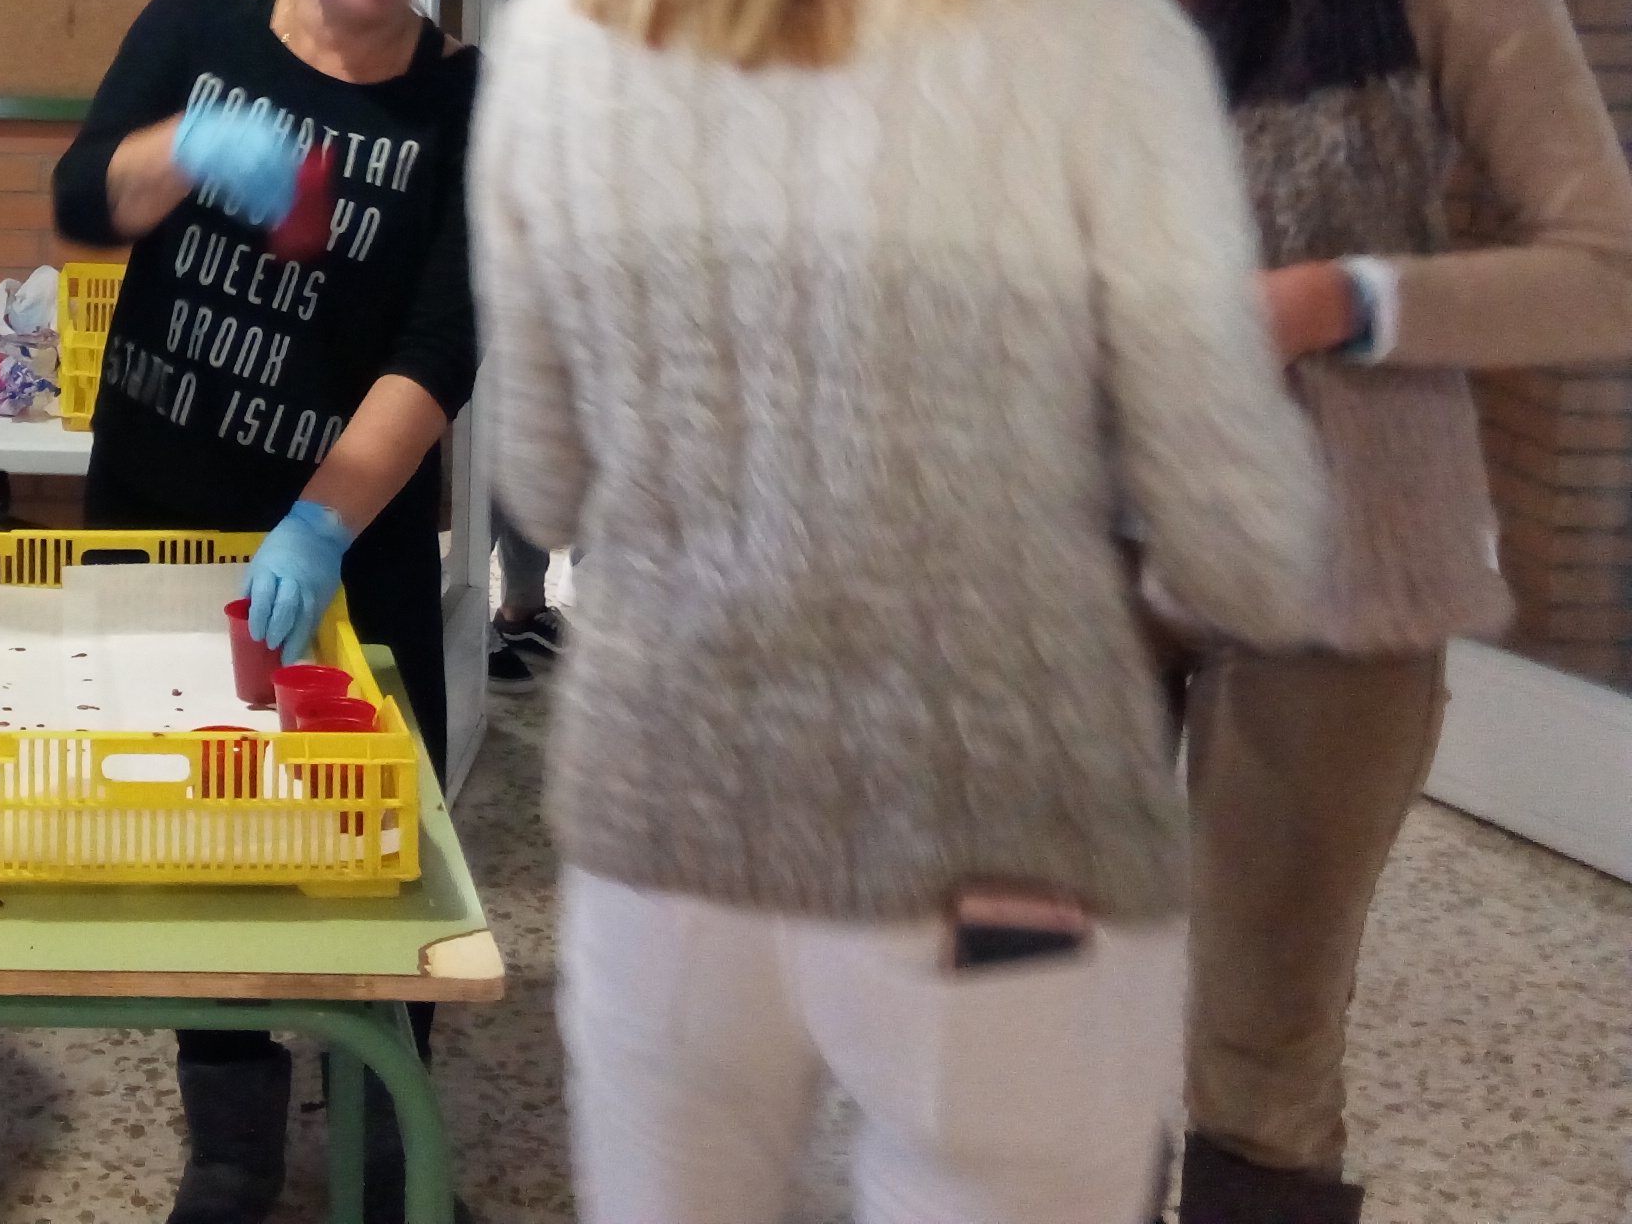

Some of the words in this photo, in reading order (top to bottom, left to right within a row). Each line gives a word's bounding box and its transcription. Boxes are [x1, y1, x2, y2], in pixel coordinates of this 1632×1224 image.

[175, 224, 325, 320] QUEENS
[167, 299, 290, 387] BRONX
[218, 390, 353, 464] ISLAN
